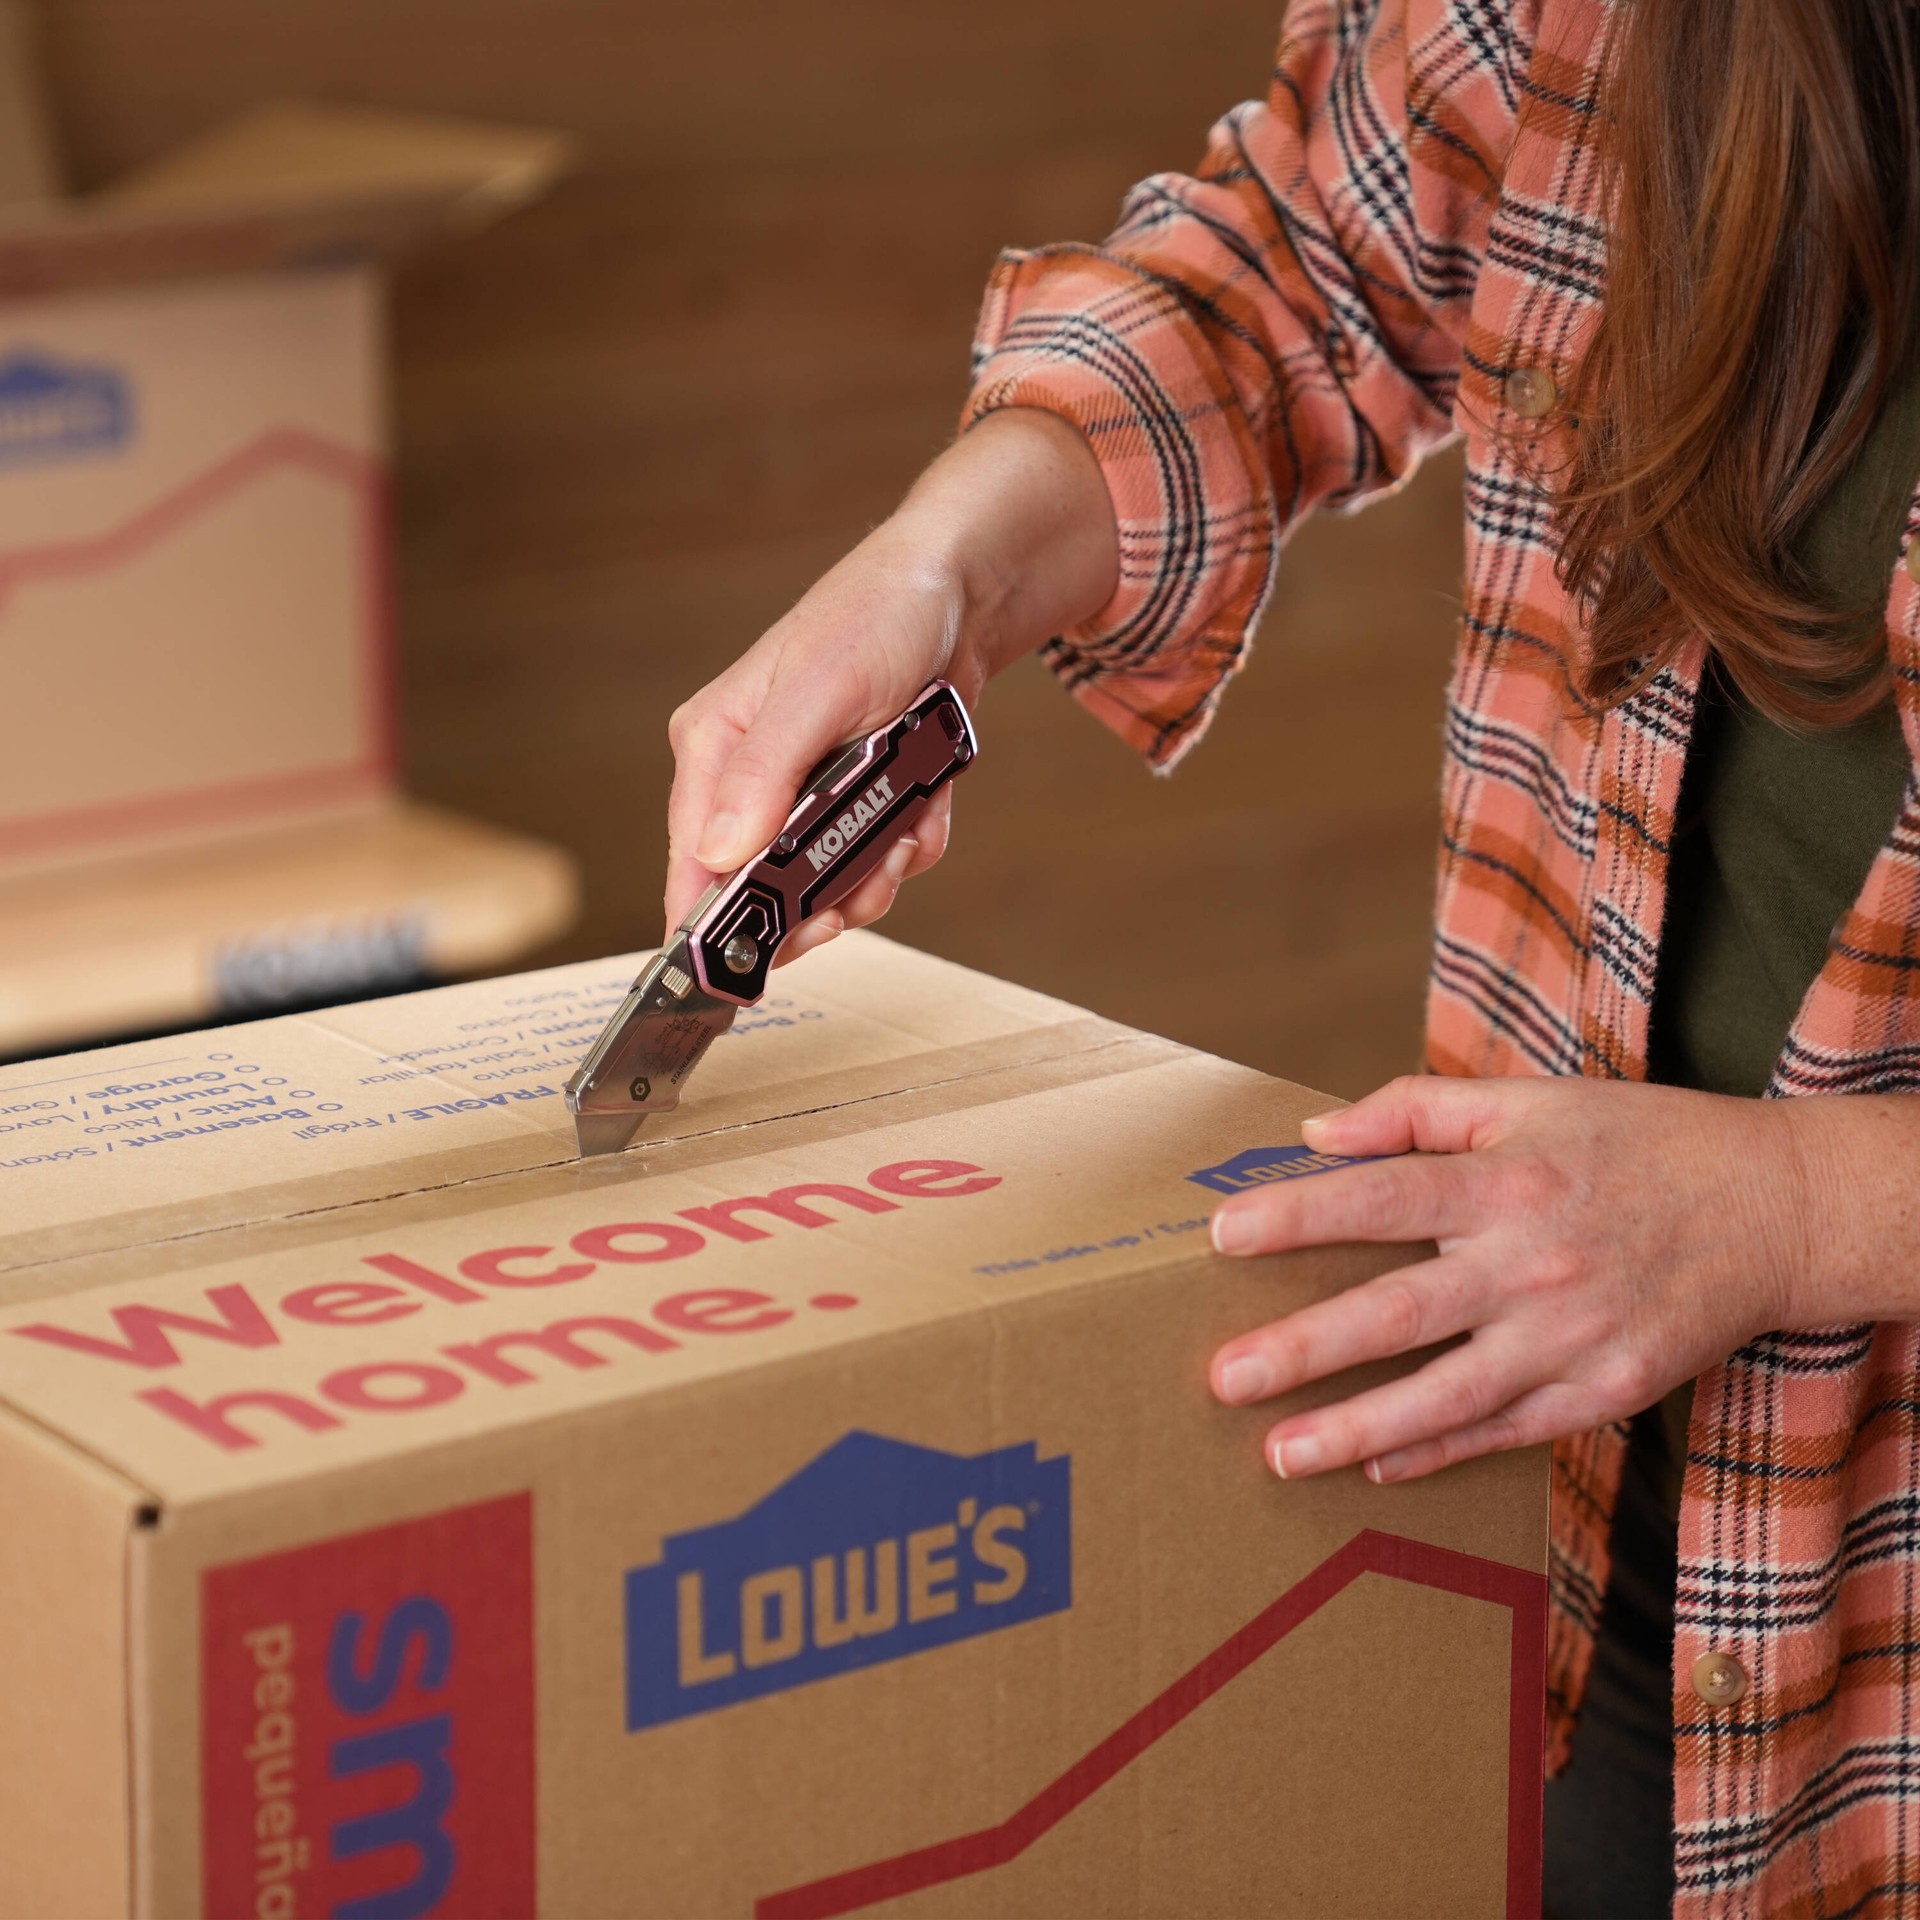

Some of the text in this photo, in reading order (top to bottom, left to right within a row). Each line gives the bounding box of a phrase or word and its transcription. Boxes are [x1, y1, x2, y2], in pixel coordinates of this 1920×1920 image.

[805, 774, 895, 872] KOBALT
[531, 1016, 609, 1036] oom
[377, 1036, 509, 1065] Comedor
[469, 1048, 536, 1065] Sala
[670, 1044, 699, 1085] STAINLESS
[694, 1024, 713, 1047] STEEL
[358, 1060, 468, 1086] familiar
[472, 1054, 588, 1082] rmitorio
[85, 1071, 227, 1099] Garage
[102, 1081, 257, 1115] Laundry
[188, 1095, 278, 1116] Attic
[401, 1085, 559, 1121] FRAGILE
[83, 1115, 163, 1134] Ático
[119, 1108, 313, 1147] Basement
[292, 1117, 383, 1140] Frágil
[0, 1146, 98, 1168] Sótan
[1210, 1153, 1352, 1188] LOWE
[6, 1159, 1003, 1371] Welcome
[130, 1287, 862, 1454] home.
[676, 1497, 1029, 1689] LOWE'S
